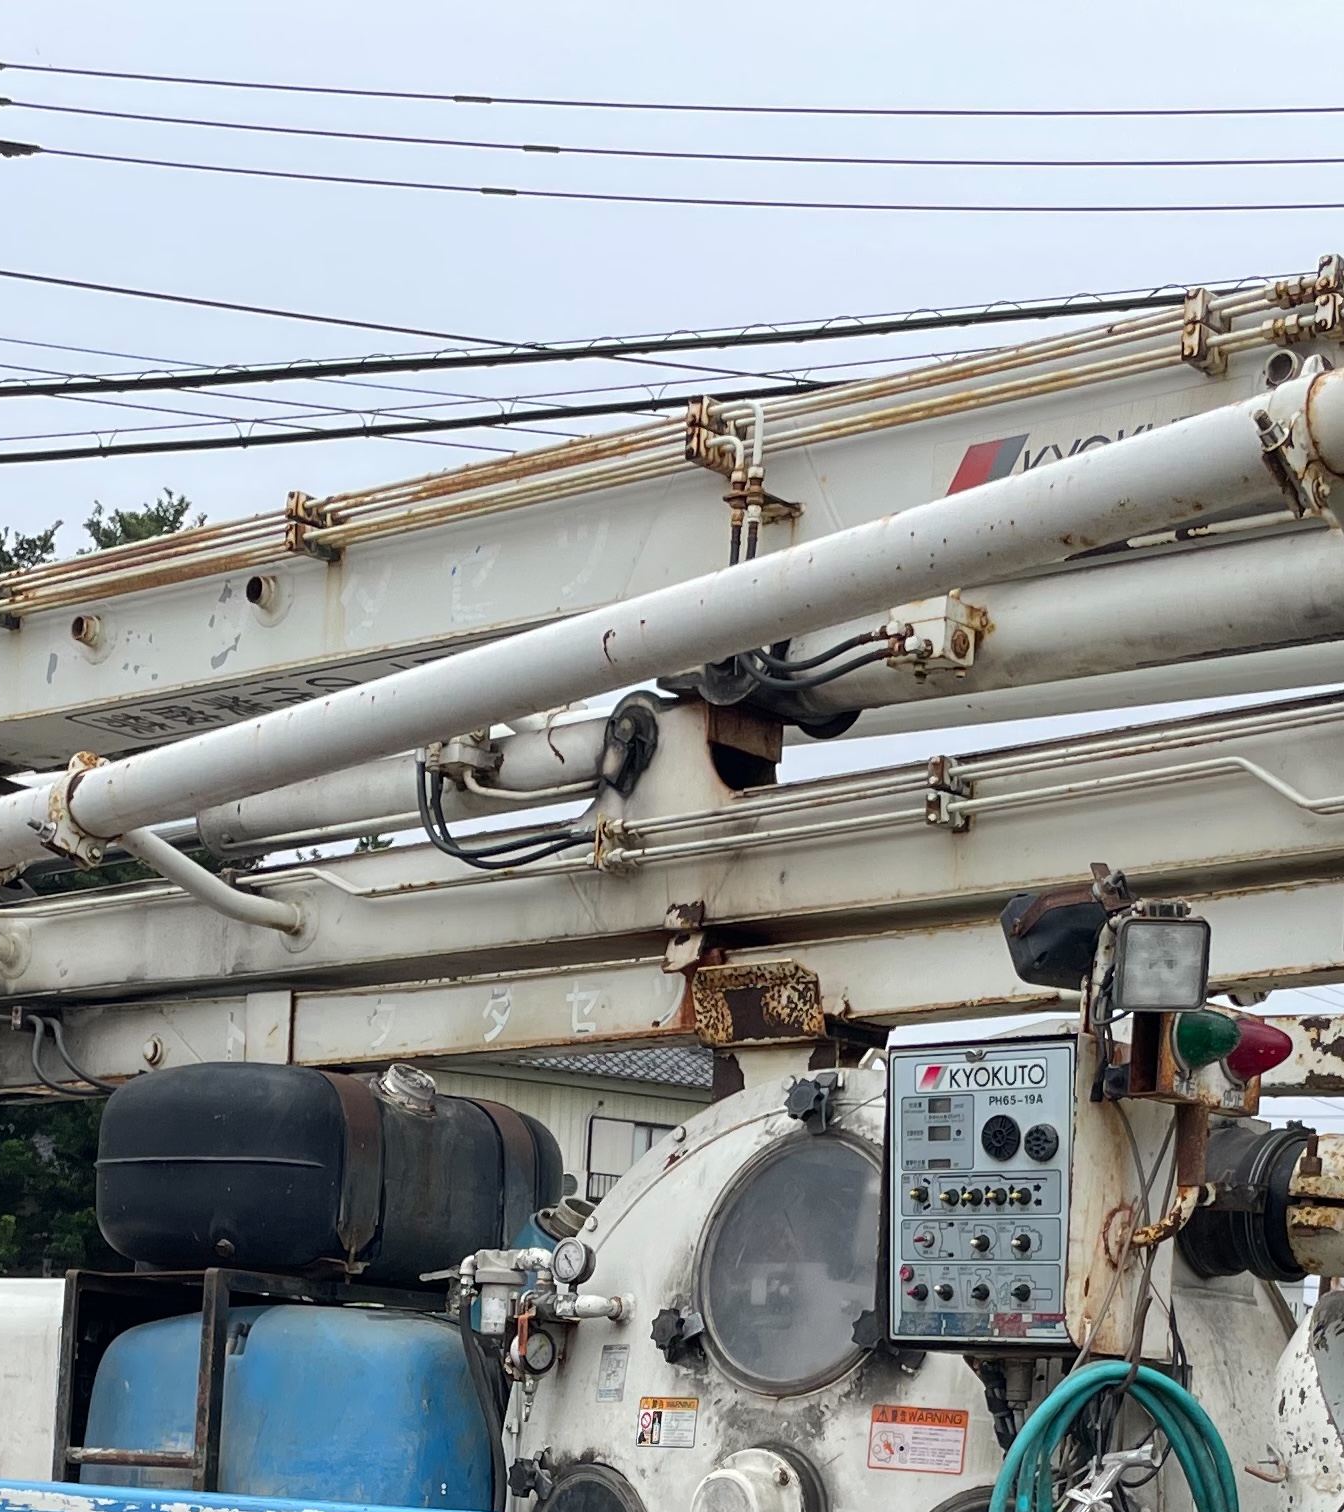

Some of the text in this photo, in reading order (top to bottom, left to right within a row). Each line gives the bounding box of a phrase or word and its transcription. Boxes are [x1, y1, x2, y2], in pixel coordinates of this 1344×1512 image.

[948, 1063, 1045, 1089] KYOKUTO
[988, 1094, 1043, 1106] PH65-19A
[666, 1399, 696, 1409] WARNING
[908, 1410, 963, 1425] WARNING
